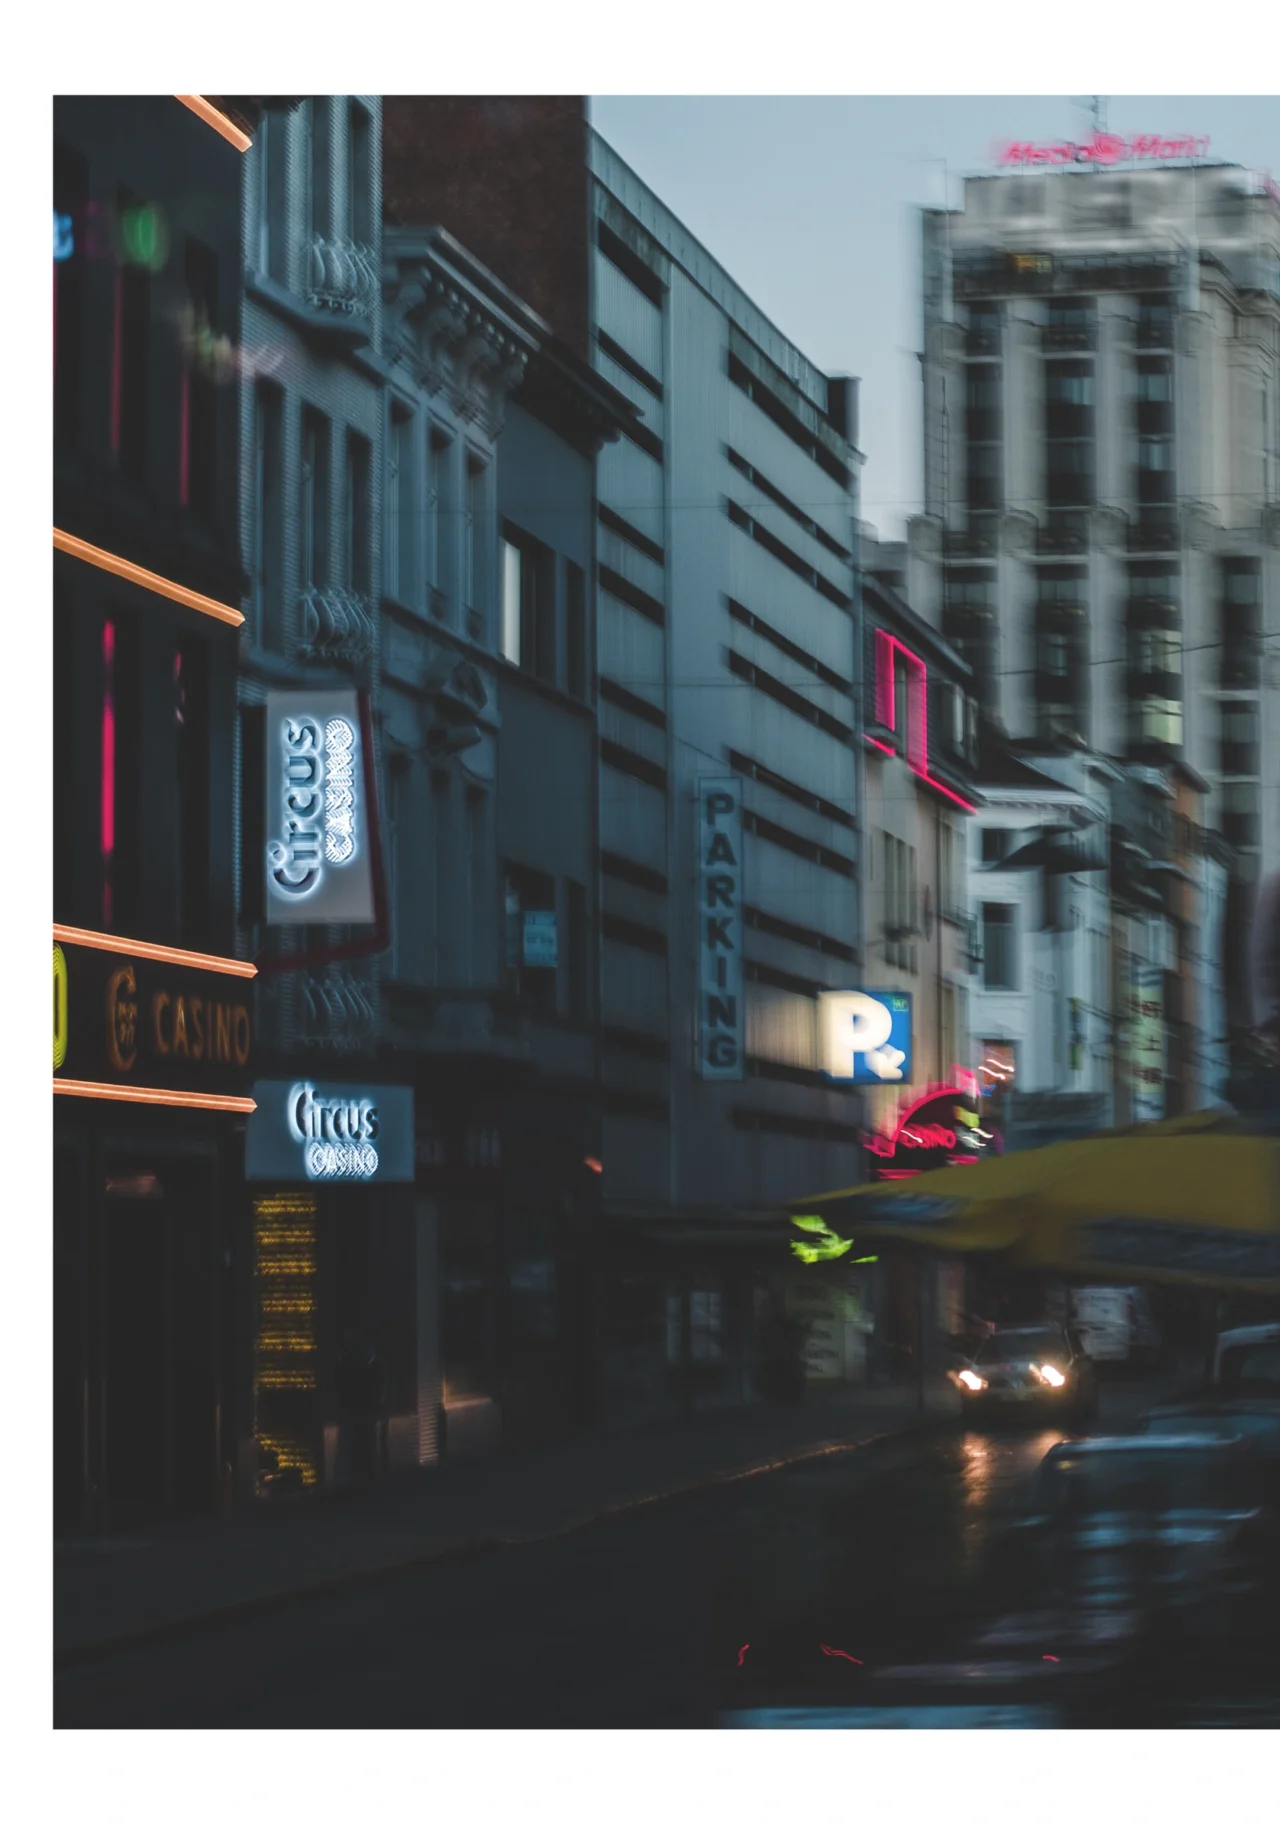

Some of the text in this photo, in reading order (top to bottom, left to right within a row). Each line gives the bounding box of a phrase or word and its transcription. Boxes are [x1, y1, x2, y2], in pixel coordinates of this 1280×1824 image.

[273, 718, 320, 895] Circus
[325, 719, 353, 863] CASINO
[706, 793, 738, 1068] PARKING
[153, 992, 249, 1066] CASINO
[288, 1082, 379, 1142] Circus
[307, 1142, 379, 1177] CASINO
